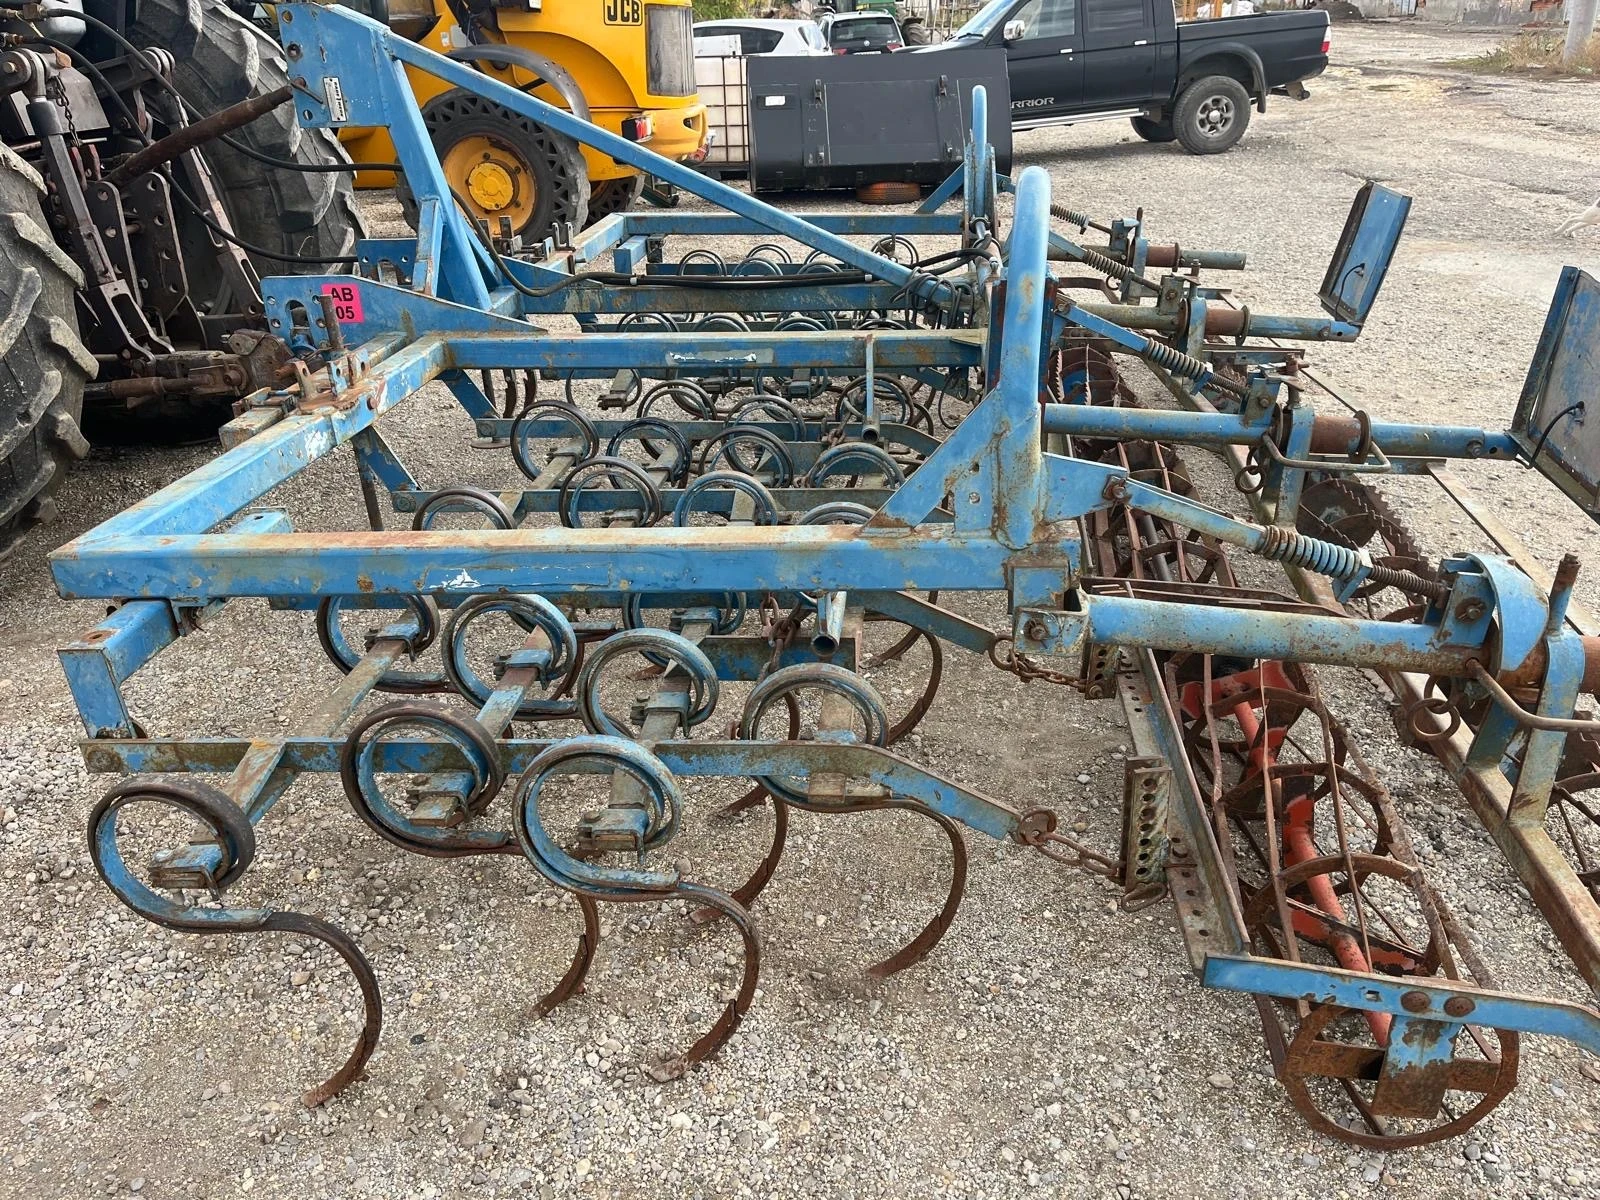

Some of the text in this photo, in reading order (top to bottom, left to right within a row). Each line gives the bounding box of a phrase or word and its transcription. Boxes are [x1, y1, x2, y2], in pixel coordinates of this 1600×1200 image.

[606, 0, 640, 23] JCB
[1011, 97, 1055, 109] RRIOR
[331, 287, 354, 302] AB
[335, 305, 355, 320] 05
